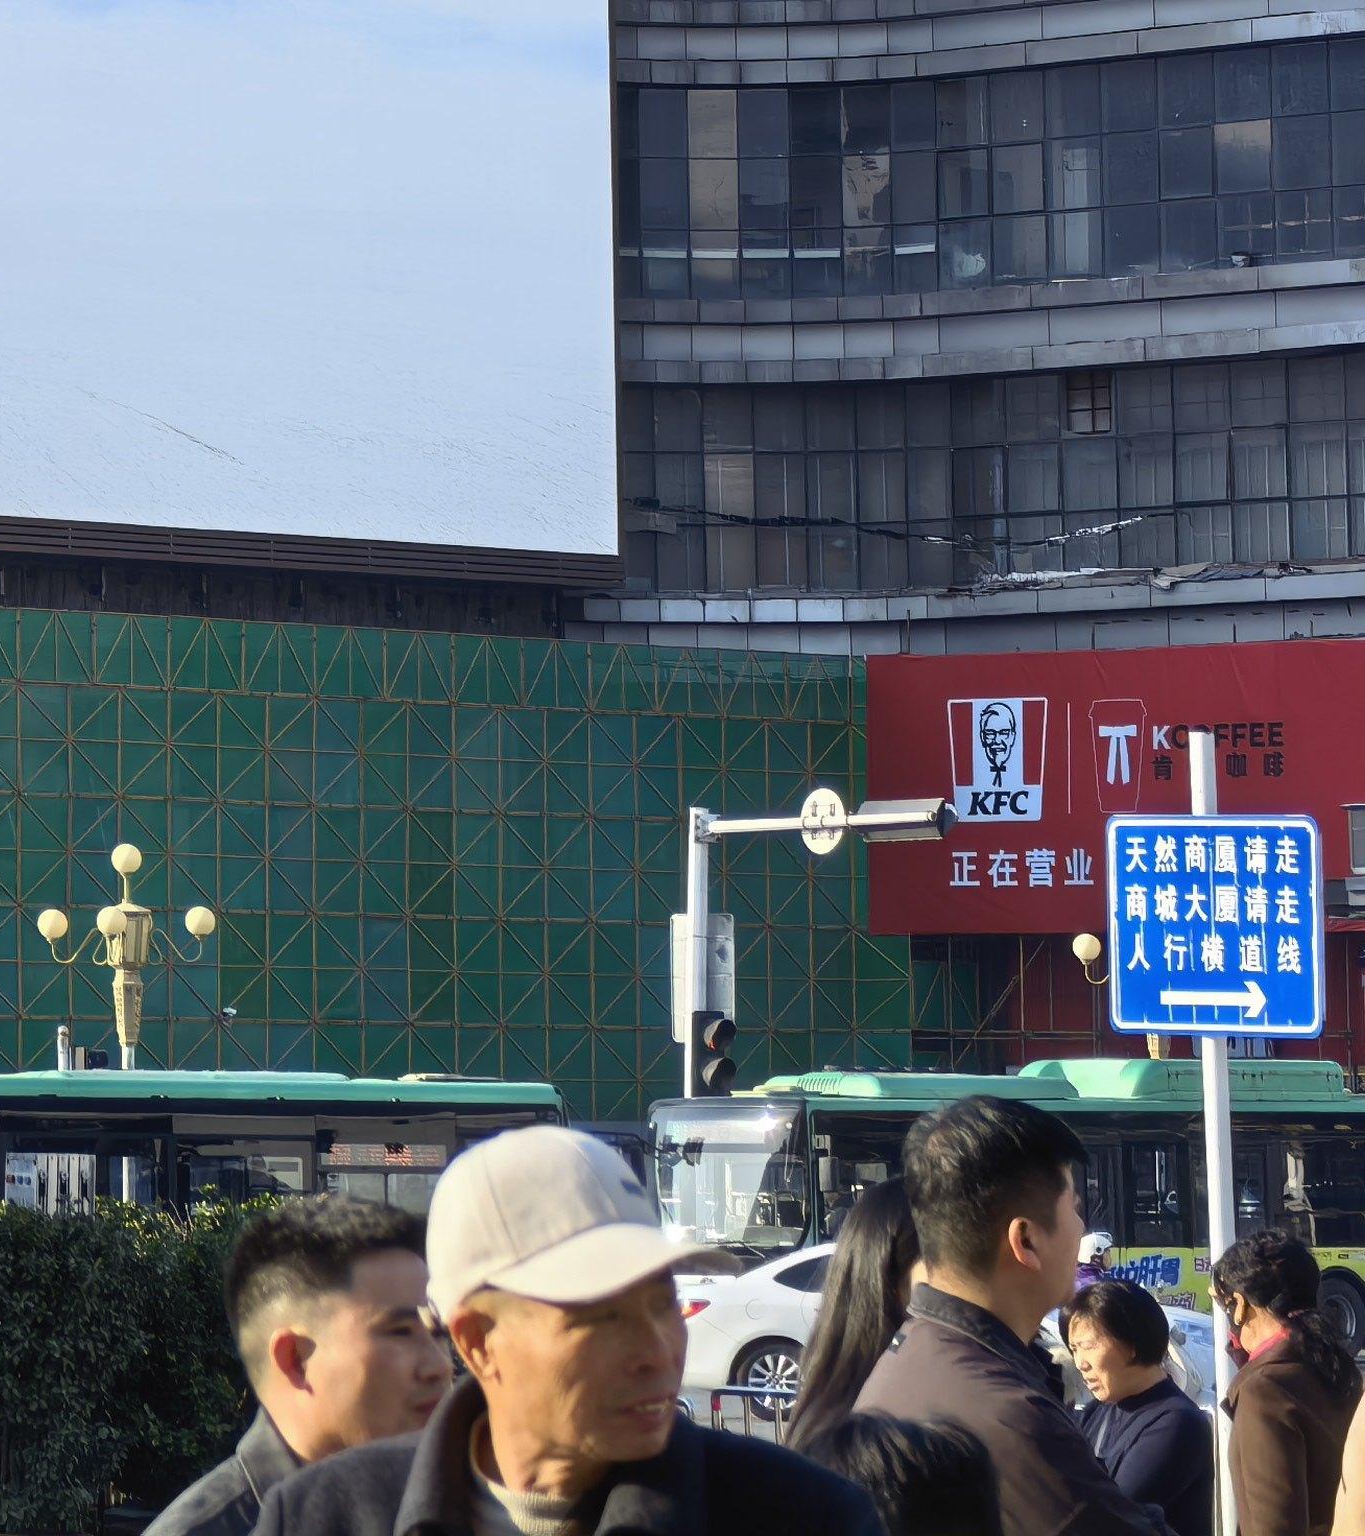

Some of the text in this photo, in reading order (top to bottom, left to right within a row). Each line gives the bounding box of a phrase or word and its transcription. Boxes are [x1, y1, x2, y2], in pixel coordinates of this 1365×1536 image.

[1152, 752, 1285, 780] 肯咖啡
[968, 790, 1029, 816] KFC
[949, 848, 1095, 888] 正在营业
[1125, 835, 1301, 875] 天然商厦请走
[1125, 884, 1301, 925] 商城大厦请走
[1126, 933, 1302, 974] 人行横道线
